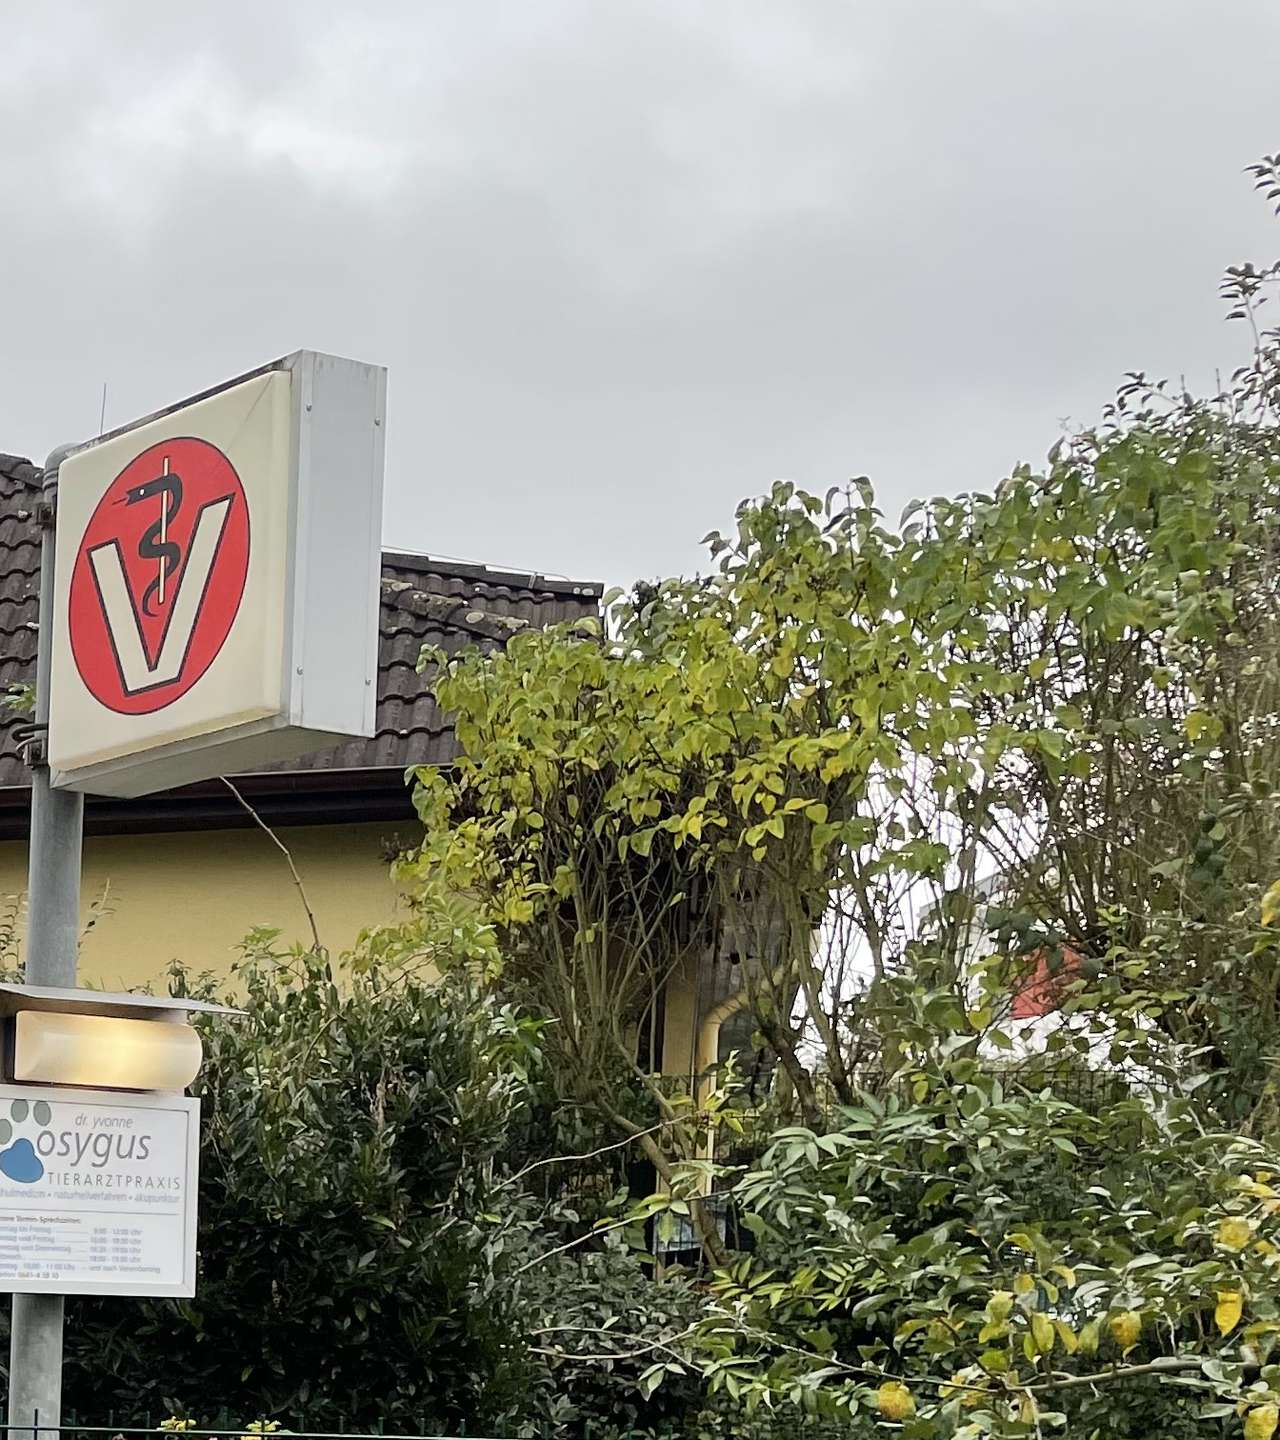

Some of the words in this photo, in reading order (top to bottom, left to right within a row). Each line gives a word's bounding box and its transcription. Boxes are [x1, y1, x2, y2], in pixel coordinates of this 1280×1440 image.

[74, 1112, 89, 1126] dr.
[92, 1115, 133, 1129] yvonne
[37, 1130, 151, 1168] osygus
[47, 1171, 181, 1190] TIERARZTPRAXIS
